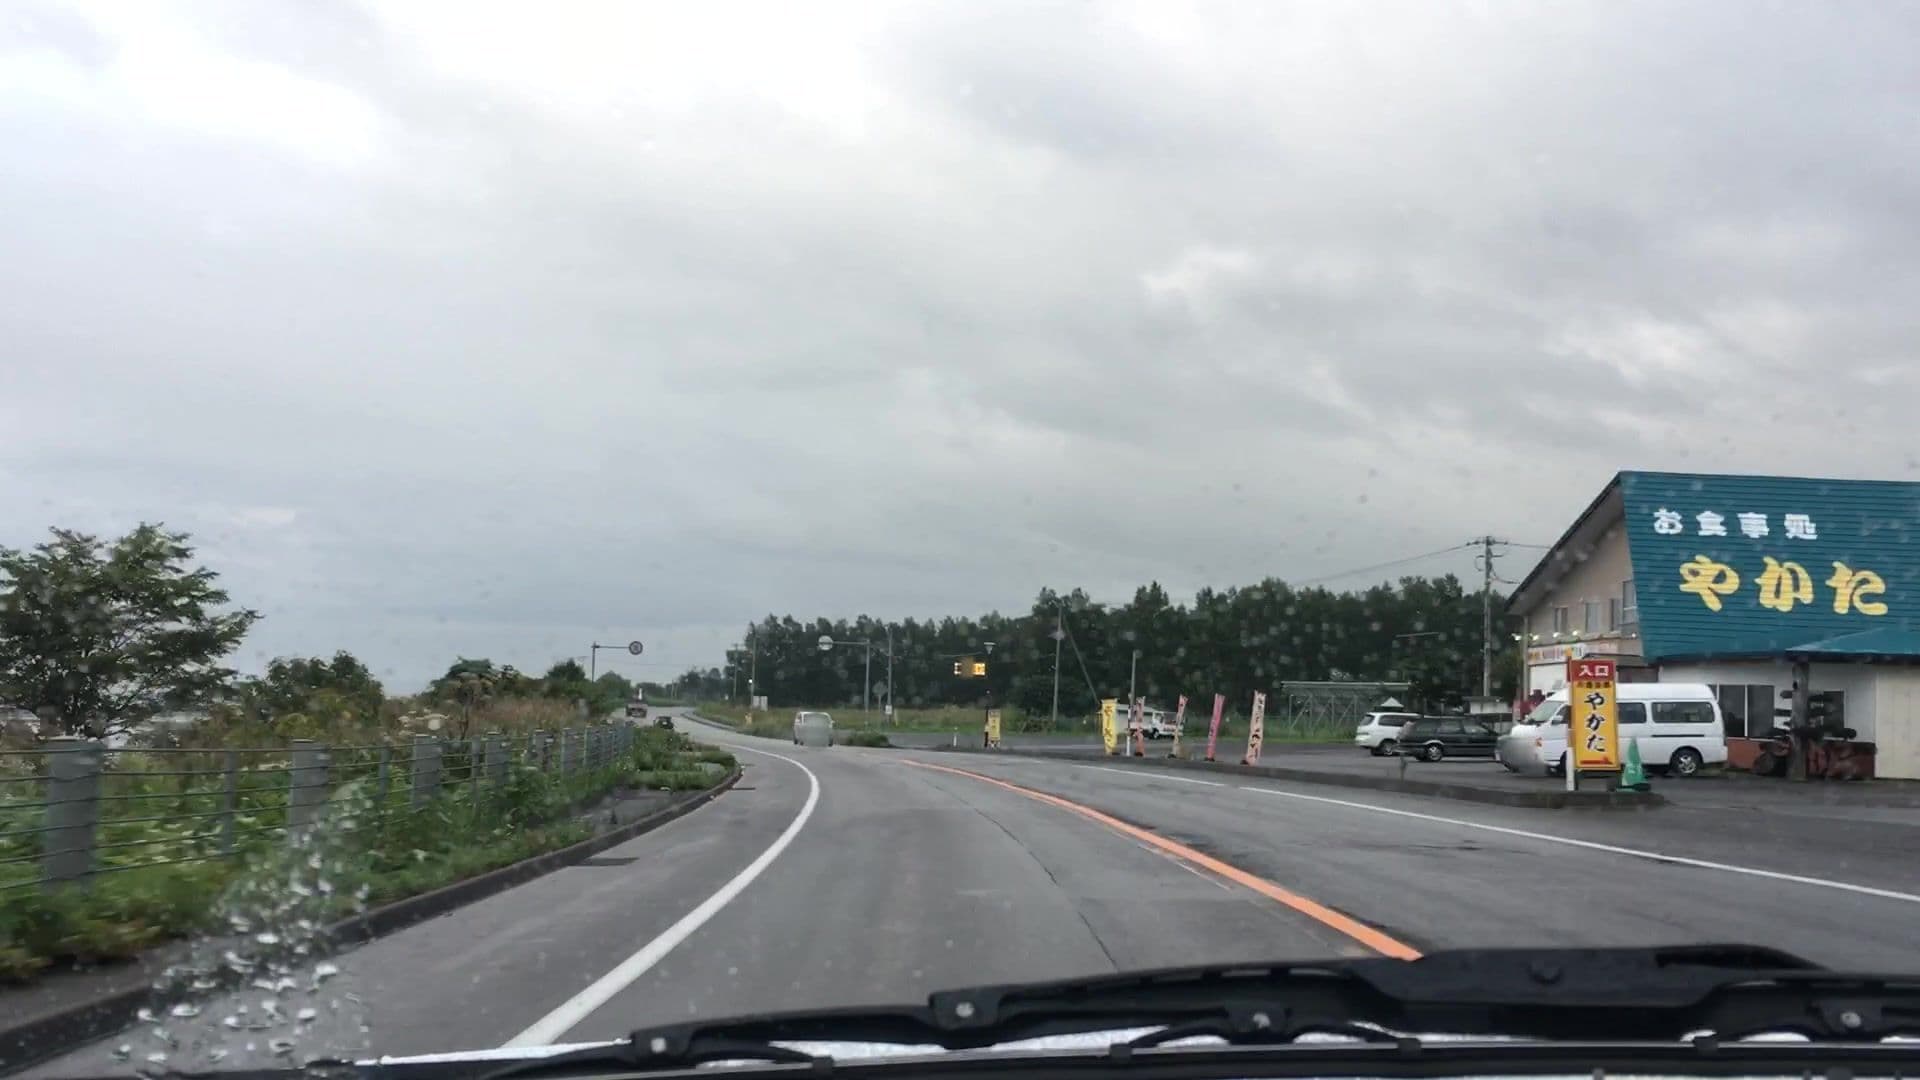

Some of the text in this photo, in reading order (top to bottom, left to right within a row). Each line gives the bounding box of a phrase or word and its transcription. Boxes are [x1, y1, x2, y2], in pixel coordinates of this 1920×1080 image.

[1652, 508, 1818, 540] お食事処
[1679, 554, 1889, 616] やかた
[1578, 664, 1610, 677] 入口
[1584, 691, 1606, 752] やかた
